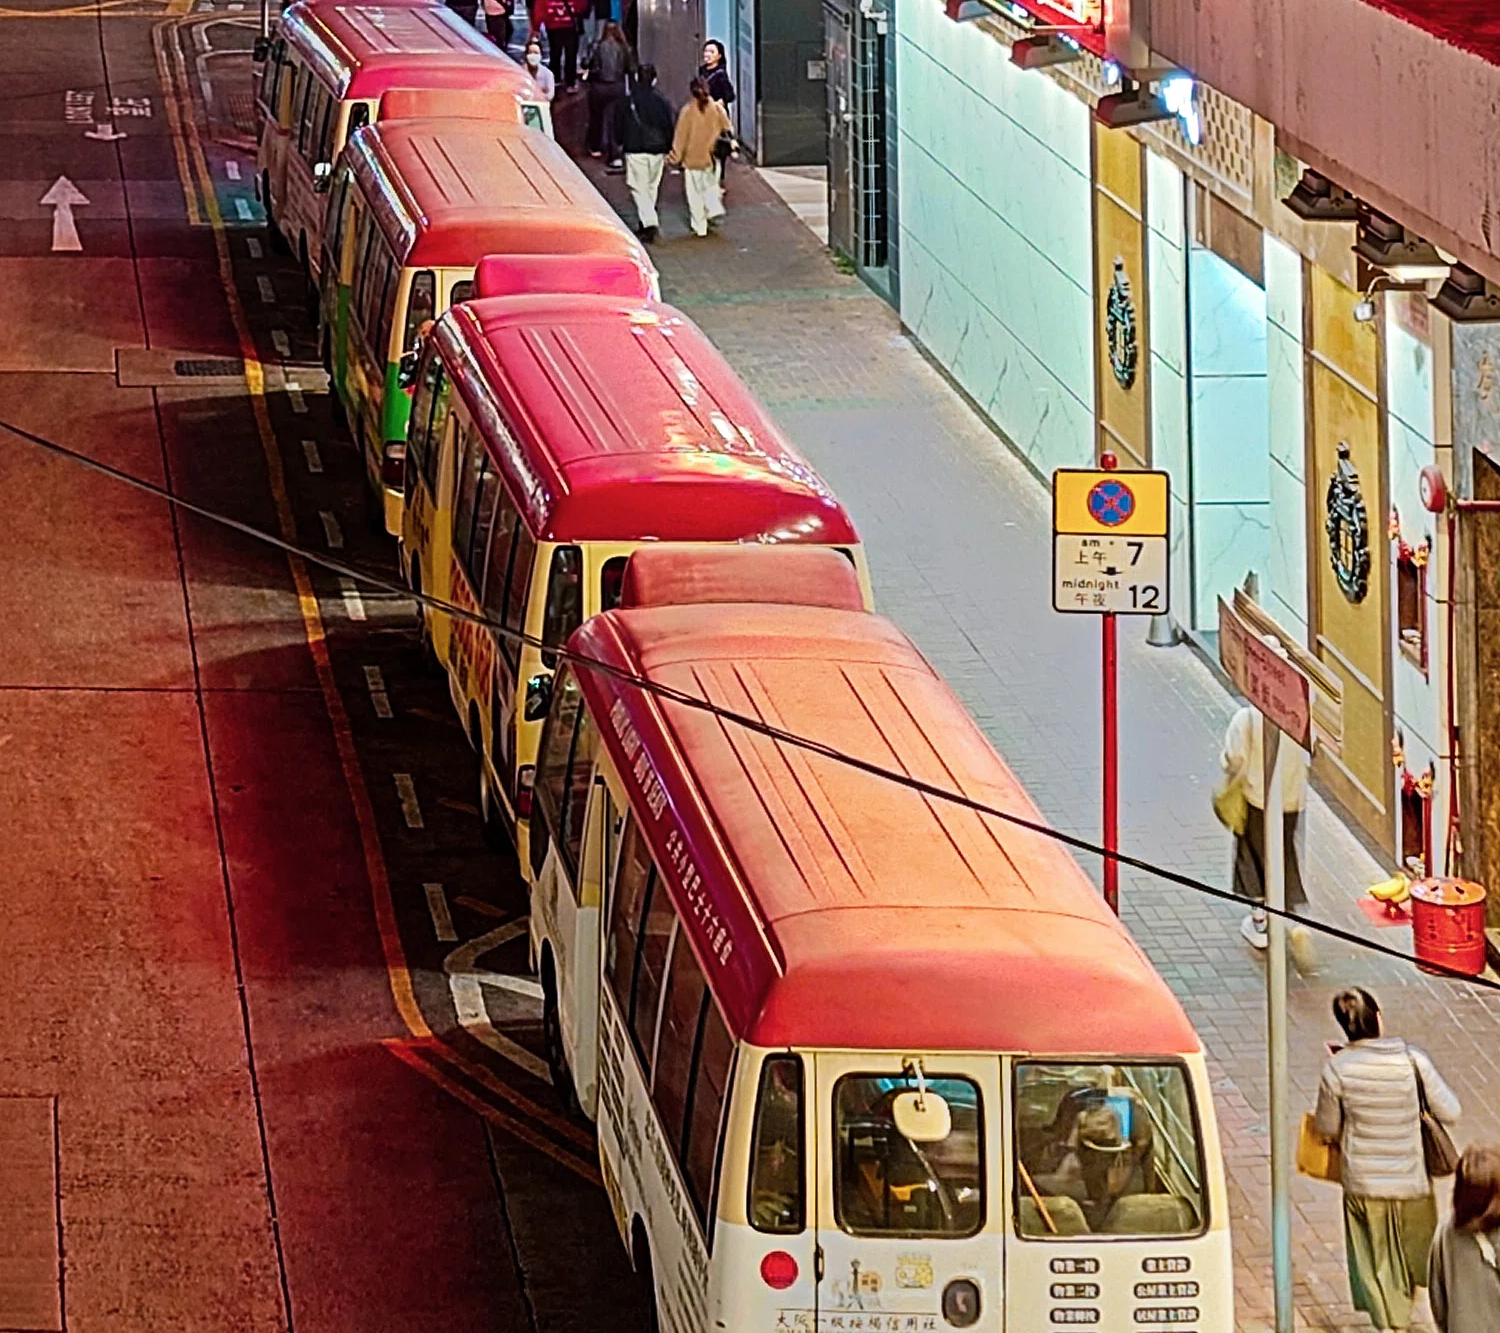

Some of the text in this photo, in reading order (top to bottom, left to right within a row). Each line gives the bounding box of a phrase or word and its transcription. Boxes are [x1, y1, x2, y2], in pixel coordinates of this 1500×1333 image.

[1074, 550, 1107, 565] 上午
[1127, 541, 1143, 565] 7
[1062, 578, 1119, 591] midnight
[1128, 585, 1160, 609] 12
